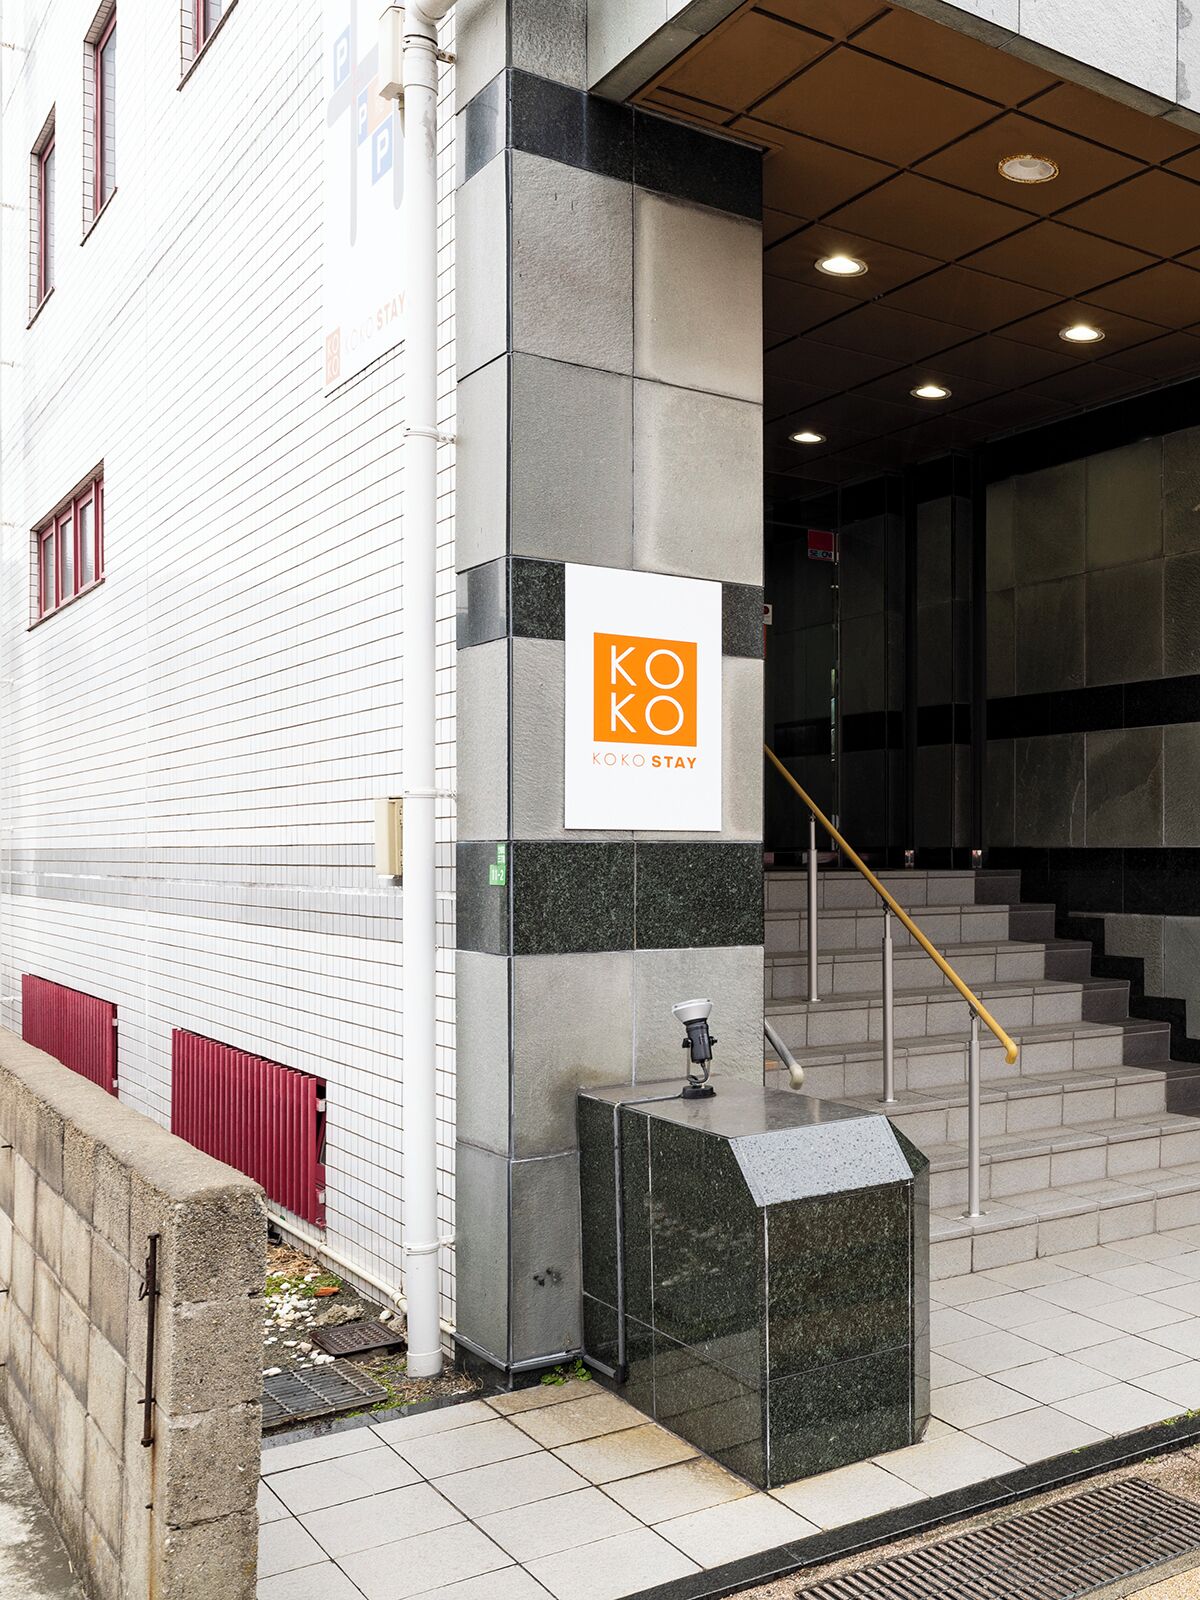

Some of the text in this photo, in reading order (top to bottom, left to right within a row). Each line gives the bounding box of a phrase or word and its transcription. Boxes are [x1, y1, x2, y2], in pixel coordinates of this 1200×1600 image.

[336, 36, 348, 81] P
[376, 128, 389, 173] P
[376, 289, 406, 331] STAY
[611, 645, 684, 690] KO
[611, 692, 684, 736] KO
[592, 752, 697, 769] KOKO STAY
